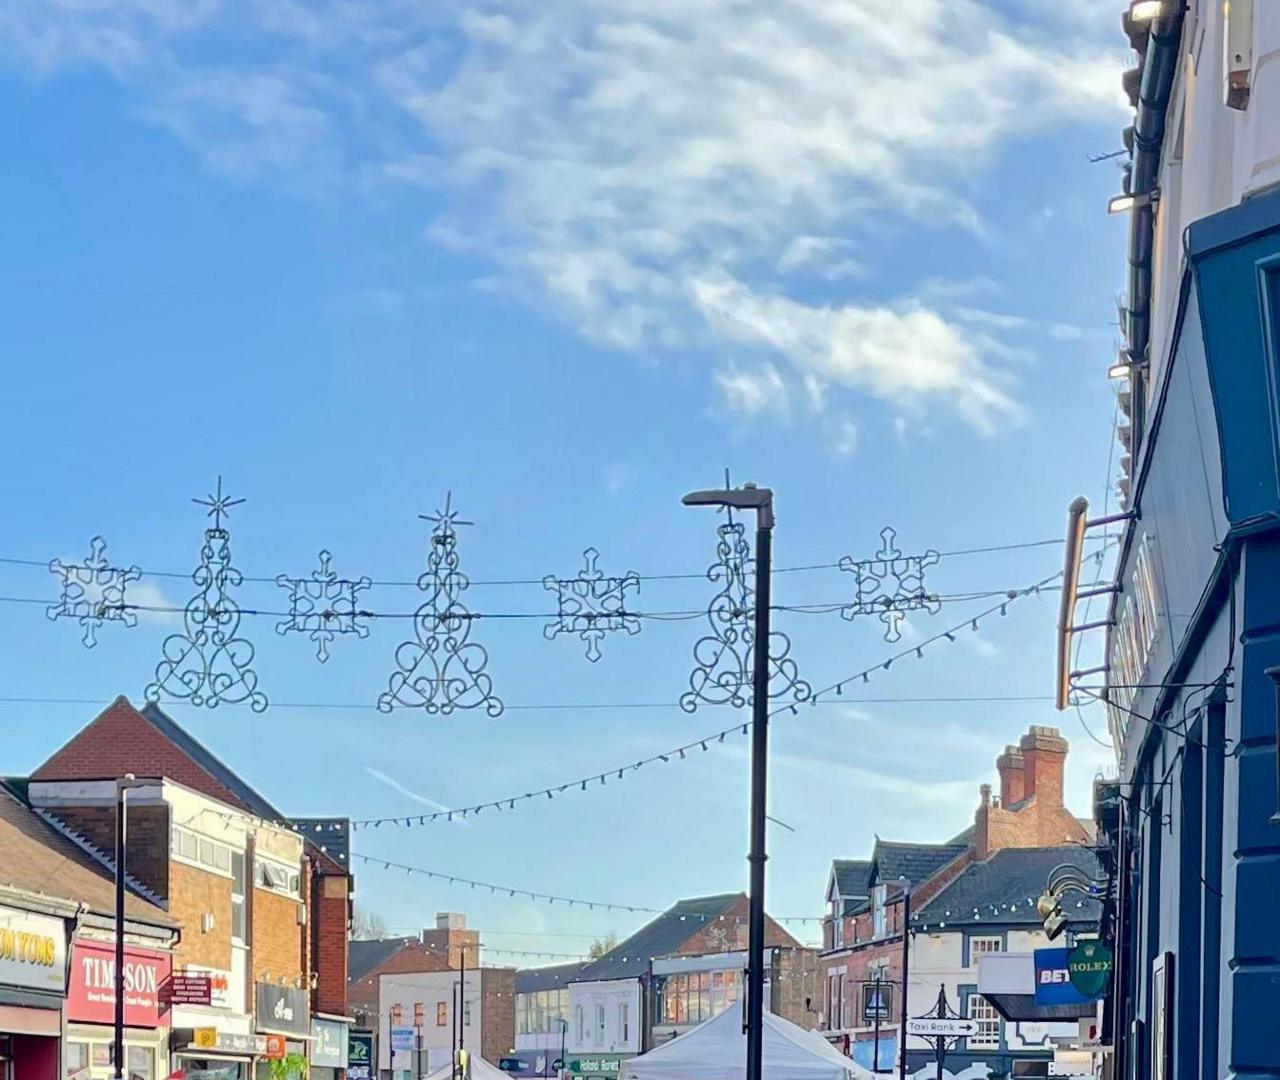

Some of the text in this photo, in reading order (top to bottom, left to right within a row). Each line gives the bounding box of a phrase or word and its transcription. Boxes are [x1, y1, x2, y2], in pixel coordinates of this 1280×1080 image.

[1070, 961, 1112, 972] ROLEX
[82, 956, 158, 994] TIMSON
[909, 1022, 956, 1031] Taxi Rank
